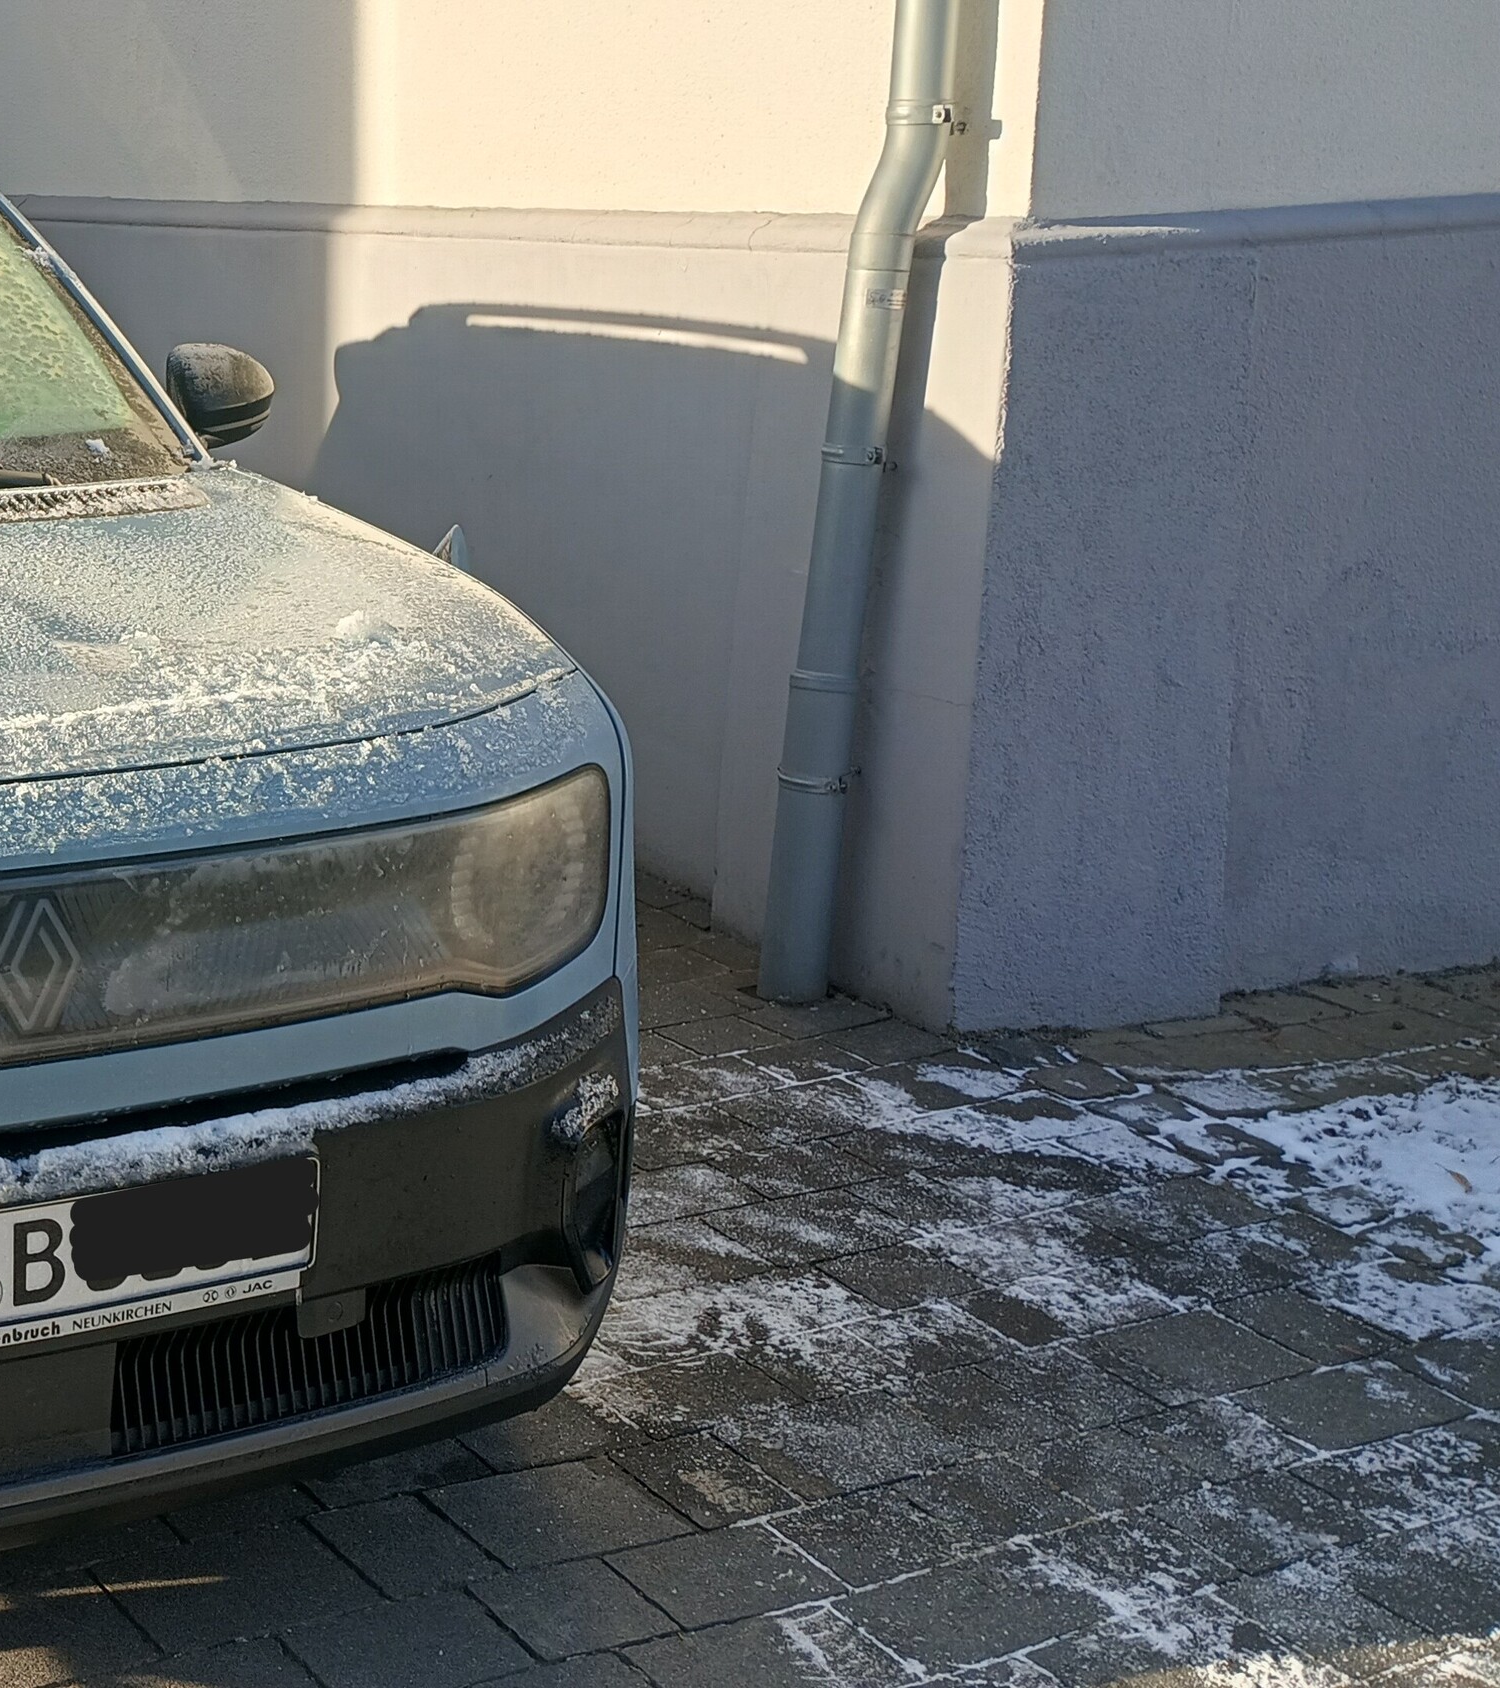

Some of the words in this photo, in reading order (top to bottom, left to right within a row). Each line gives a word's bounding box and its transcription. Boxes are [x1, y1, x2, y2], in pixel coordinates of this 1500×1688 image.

[13, 1218, 66, 1307] B
[242, 1280, 273, 1294] JAC
[72, 1301, 173, 1331] NEUNKIRCHEN
